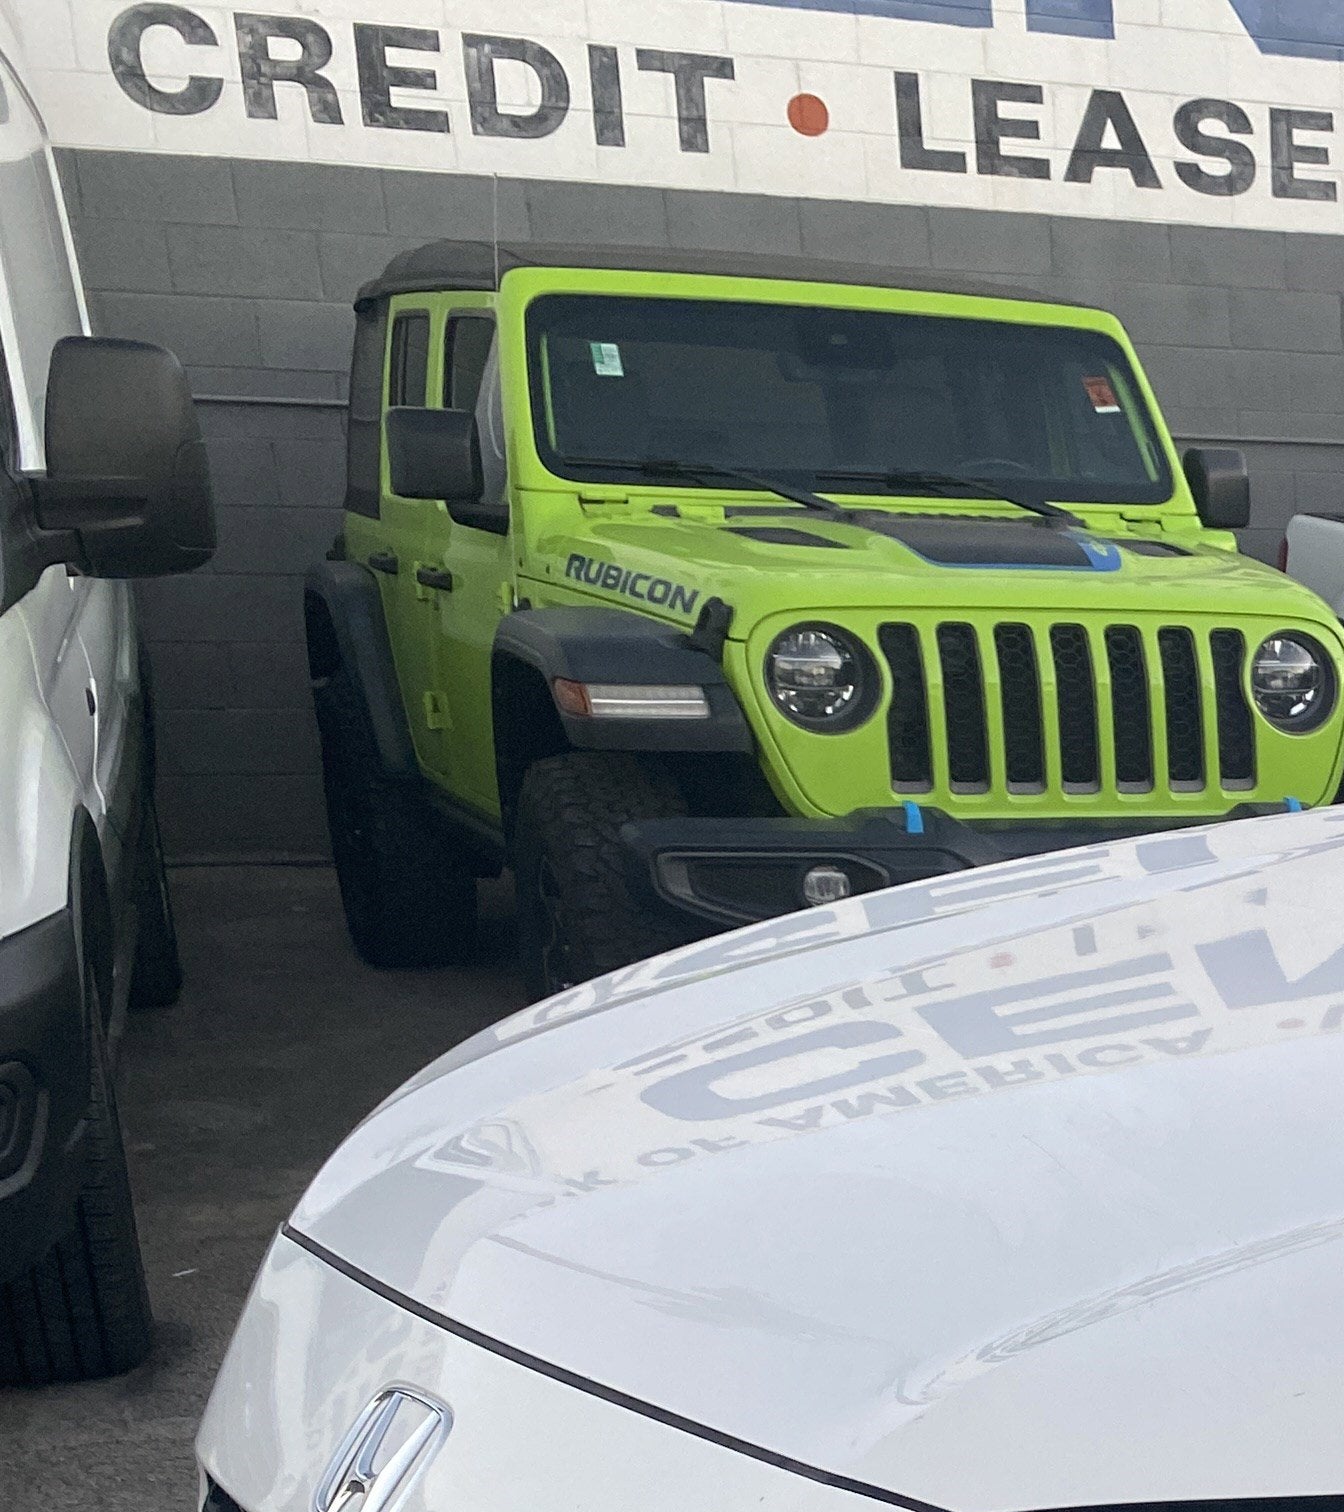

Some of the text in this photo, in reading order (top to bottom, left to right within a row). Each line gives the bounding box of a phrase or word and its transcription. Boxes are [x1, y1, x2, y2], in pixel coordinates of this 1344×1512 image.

[107, 2, 735, 154] CREDIT
[892, 71, 1337, 203] LEASE
[565, 552, 700, 614] RUBICON
